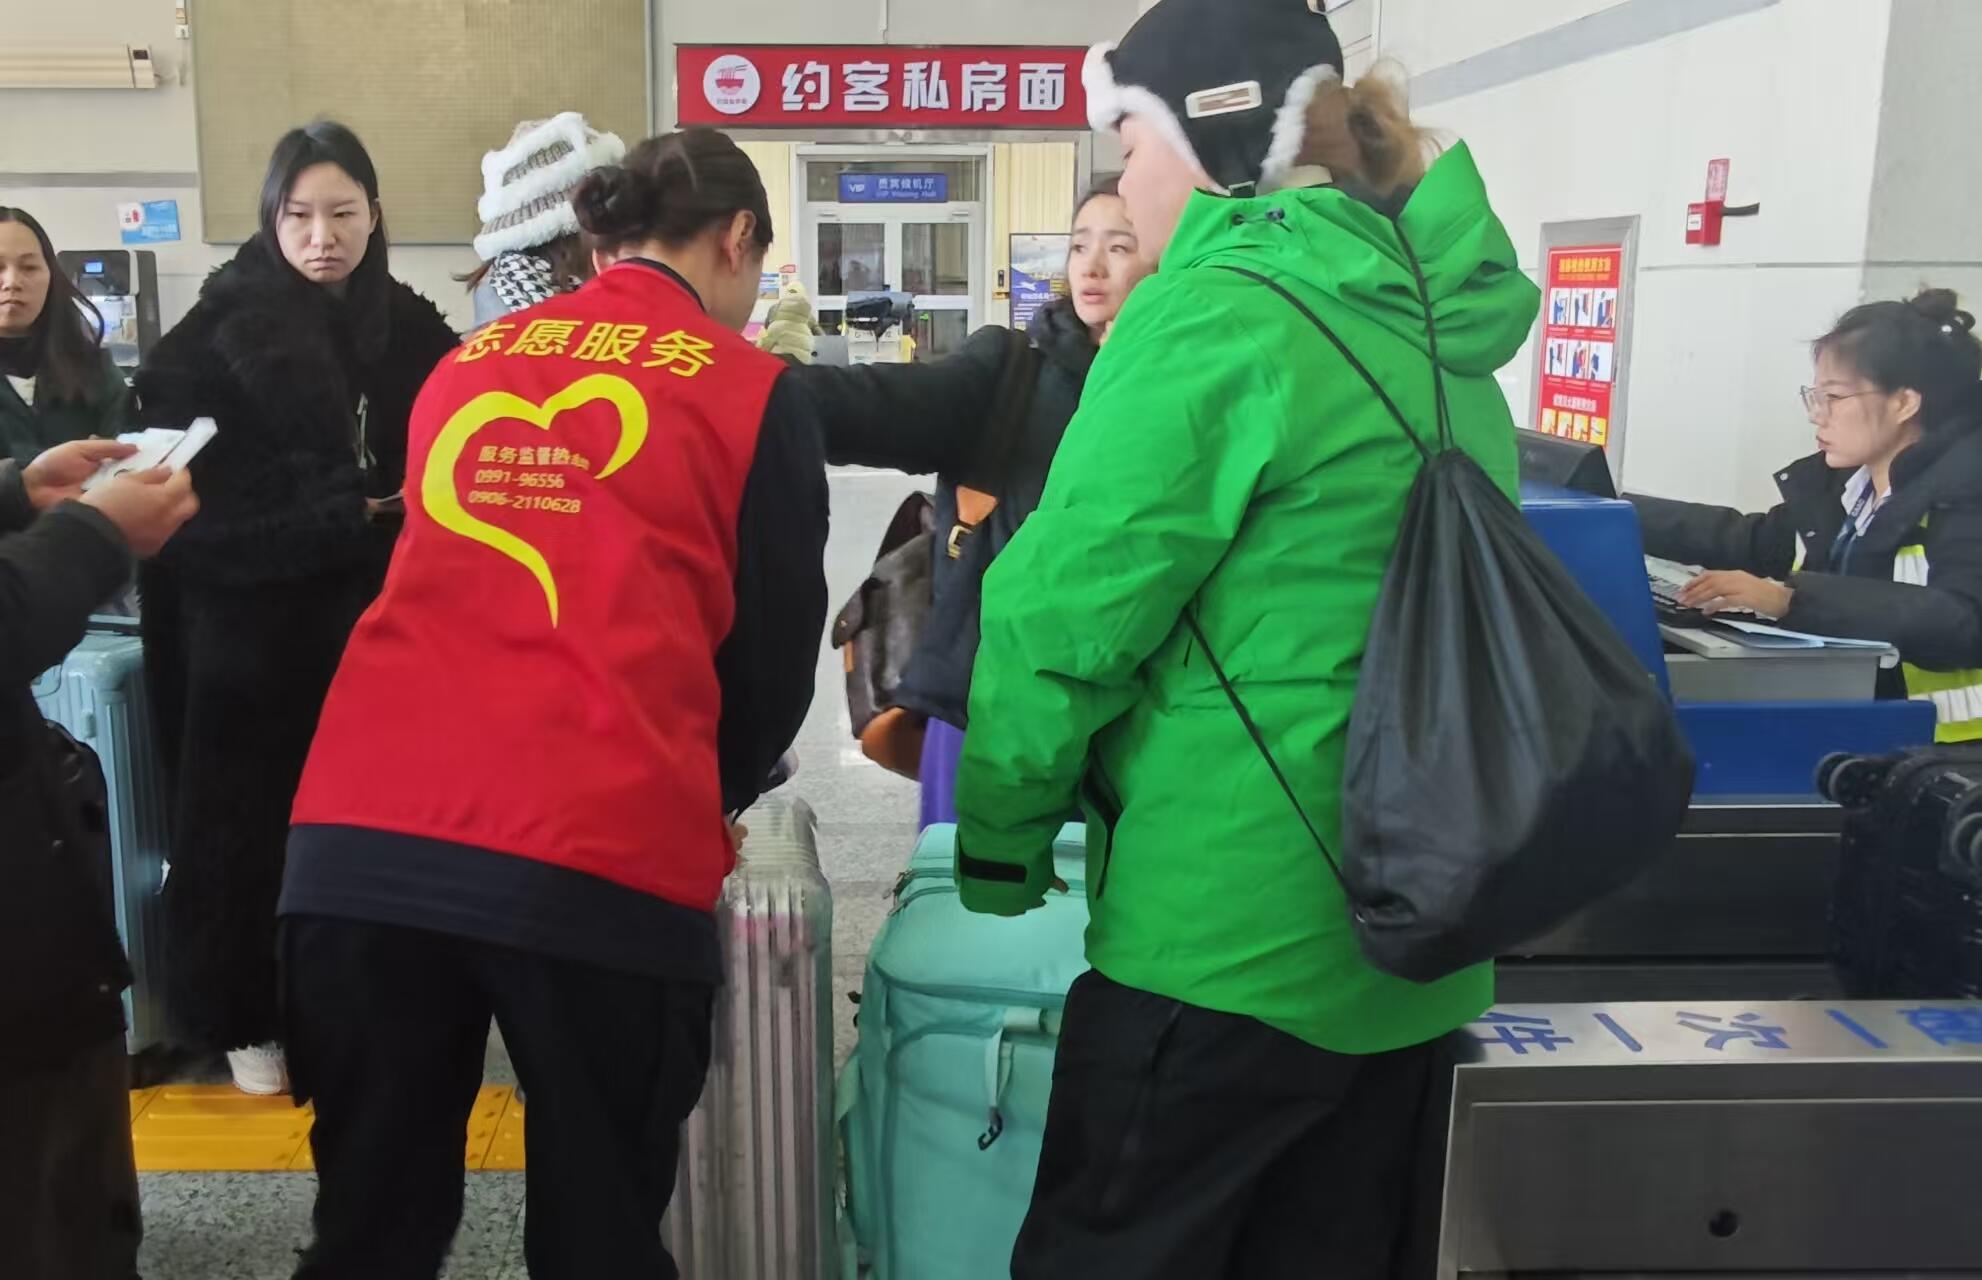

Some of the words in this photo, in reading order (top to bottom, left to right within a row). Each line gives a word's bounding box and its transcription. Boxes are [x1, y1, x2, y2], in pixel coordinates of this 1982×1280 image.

[781, 60, 1066, 112] 约客私房面
[848, 184, 865, 192] VIP
[454, 319, 715, 377] 志愿服务
